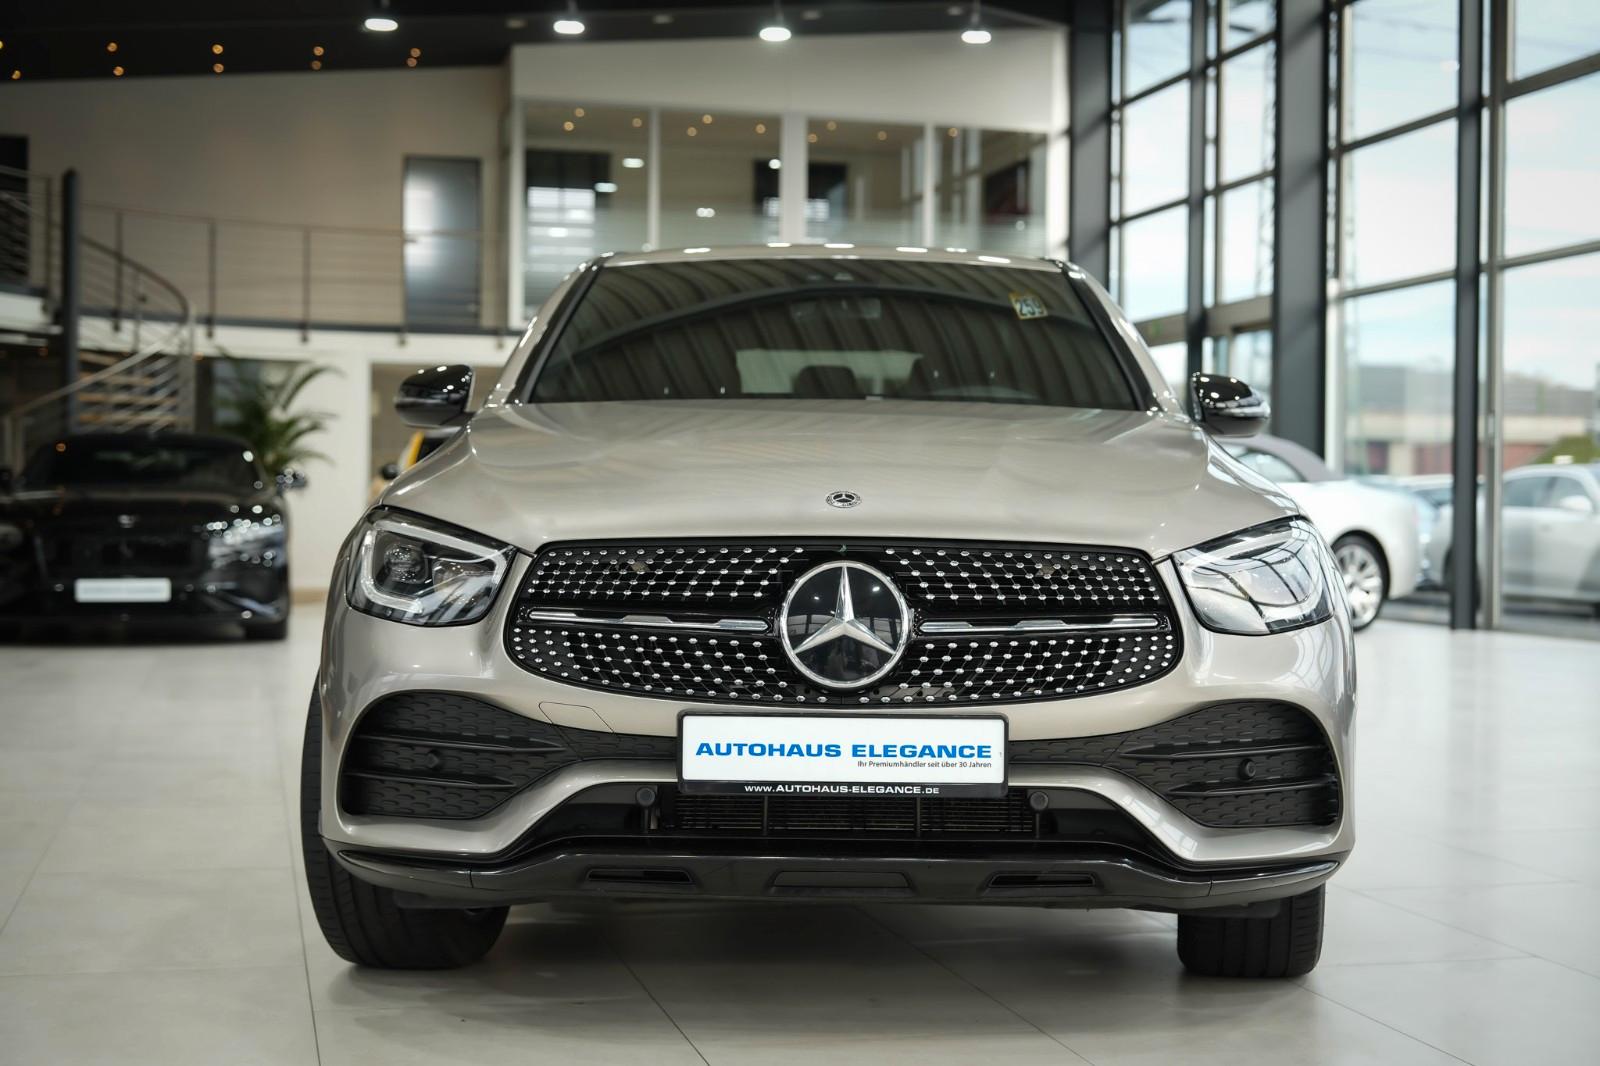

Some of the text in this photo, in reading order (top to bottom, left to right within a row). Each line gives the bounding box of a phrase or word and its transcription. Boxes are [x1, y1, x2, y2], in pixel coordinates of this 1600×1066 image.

[696, 742, 992, 758] AUTOHAUS ELEGANCE
[857, 760, 867, 768] Ihr
[868, 760, 926, 768] Premiumhändler
[927, 760, 940, 768] seit
[941, 760, 957, 768] über
[969, 761, 992, 769] Jahren
[744, 784, 940, 794] www.AUTOHAUS-ELEGANCE.DE
